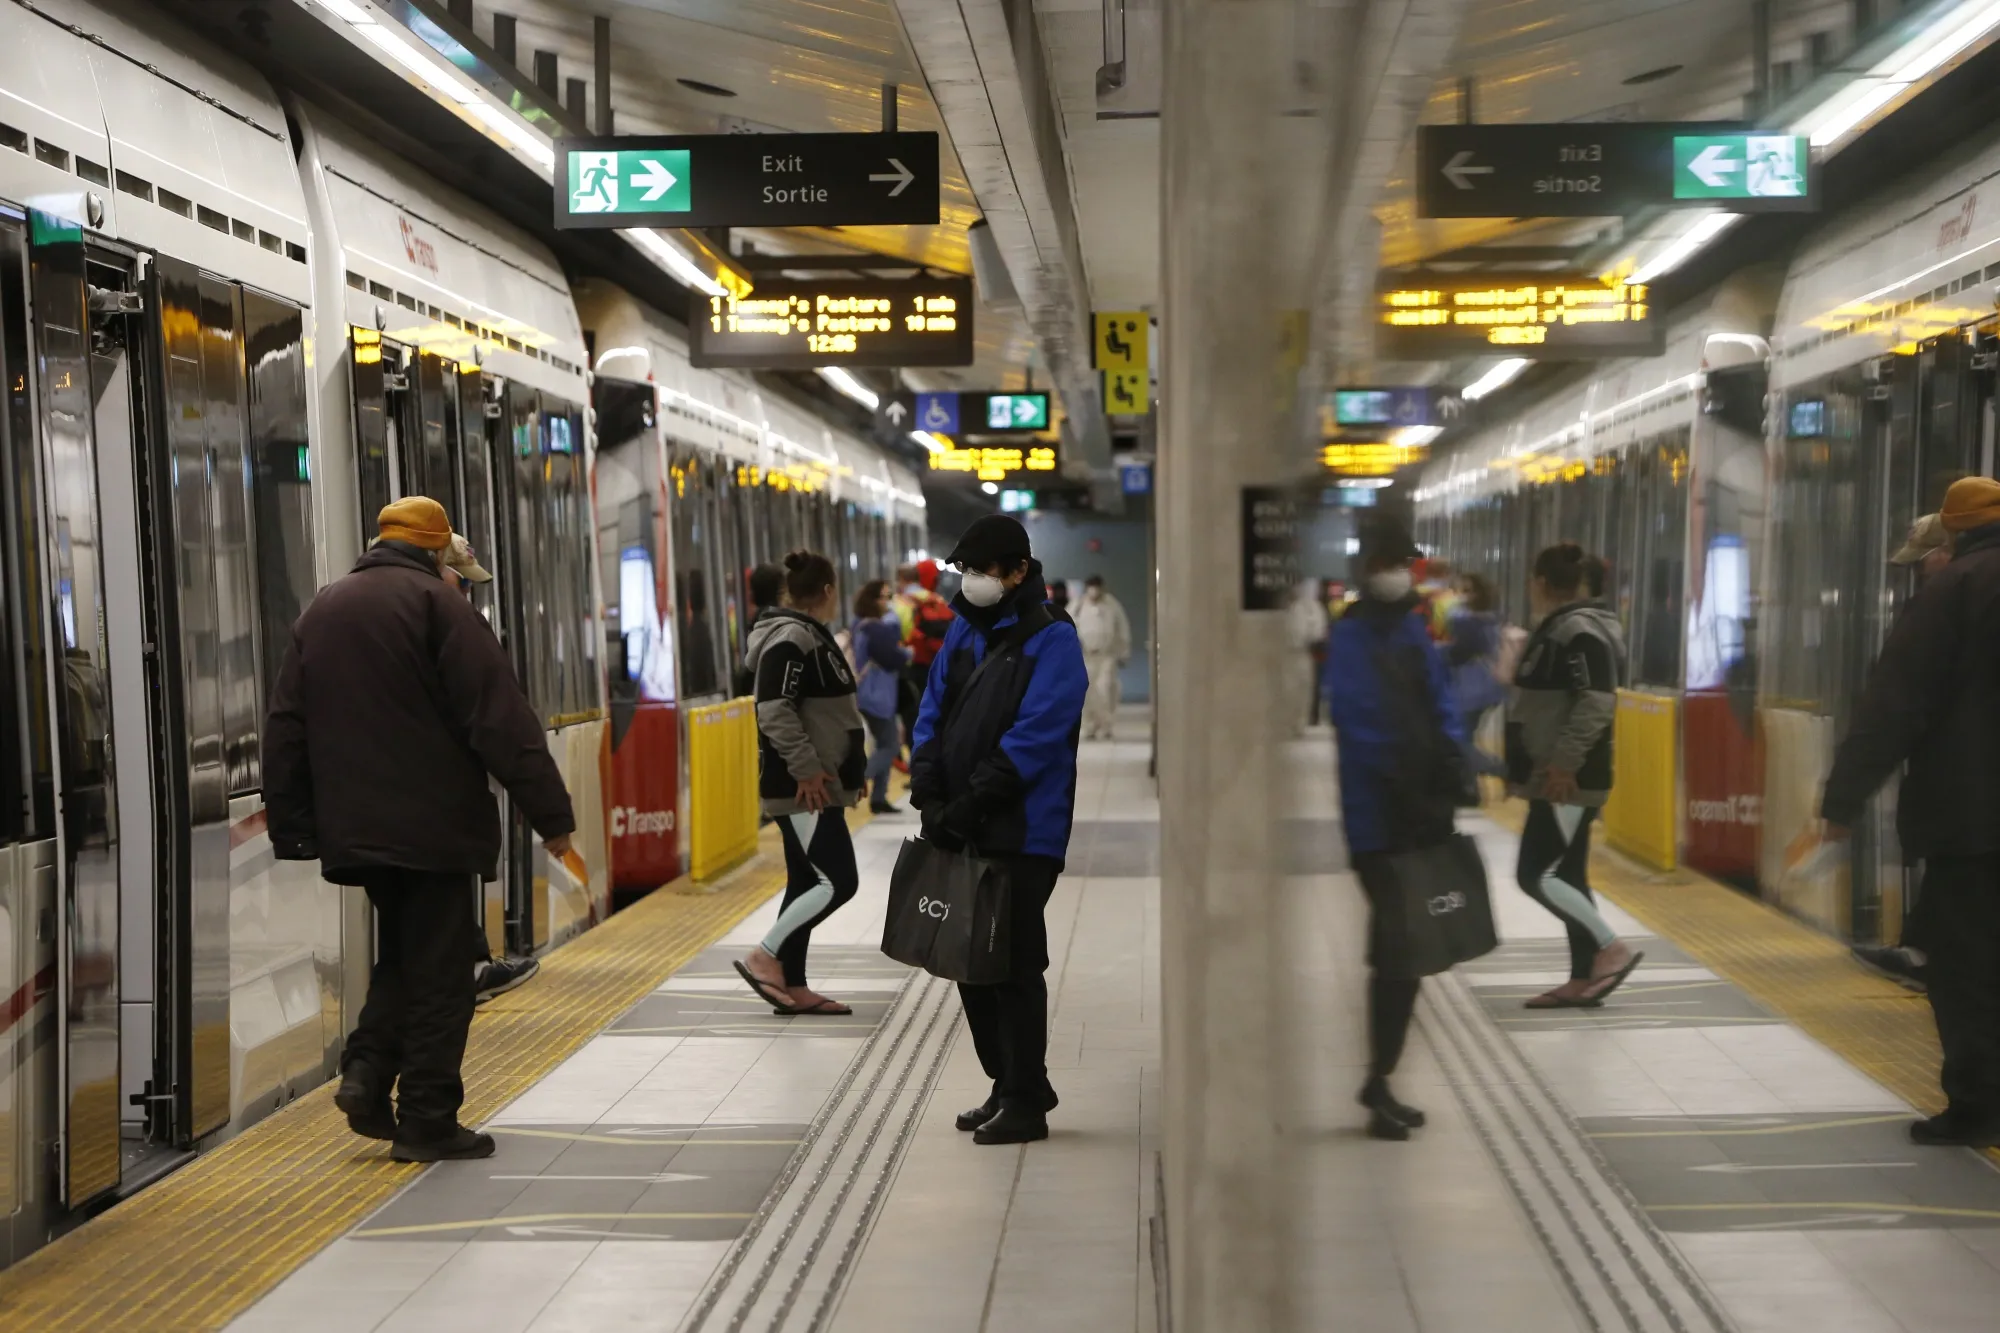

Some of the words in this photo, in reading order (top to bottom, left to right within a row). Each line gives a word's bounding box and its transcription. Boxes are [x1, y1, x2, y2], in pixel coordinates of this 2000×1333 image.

[762, 154, 803, 172] Exit
[763, 185, 828, 203] Sortie
[816, 314, 891, 332] Pasture
[626, 806, 675, 837] Transpo
